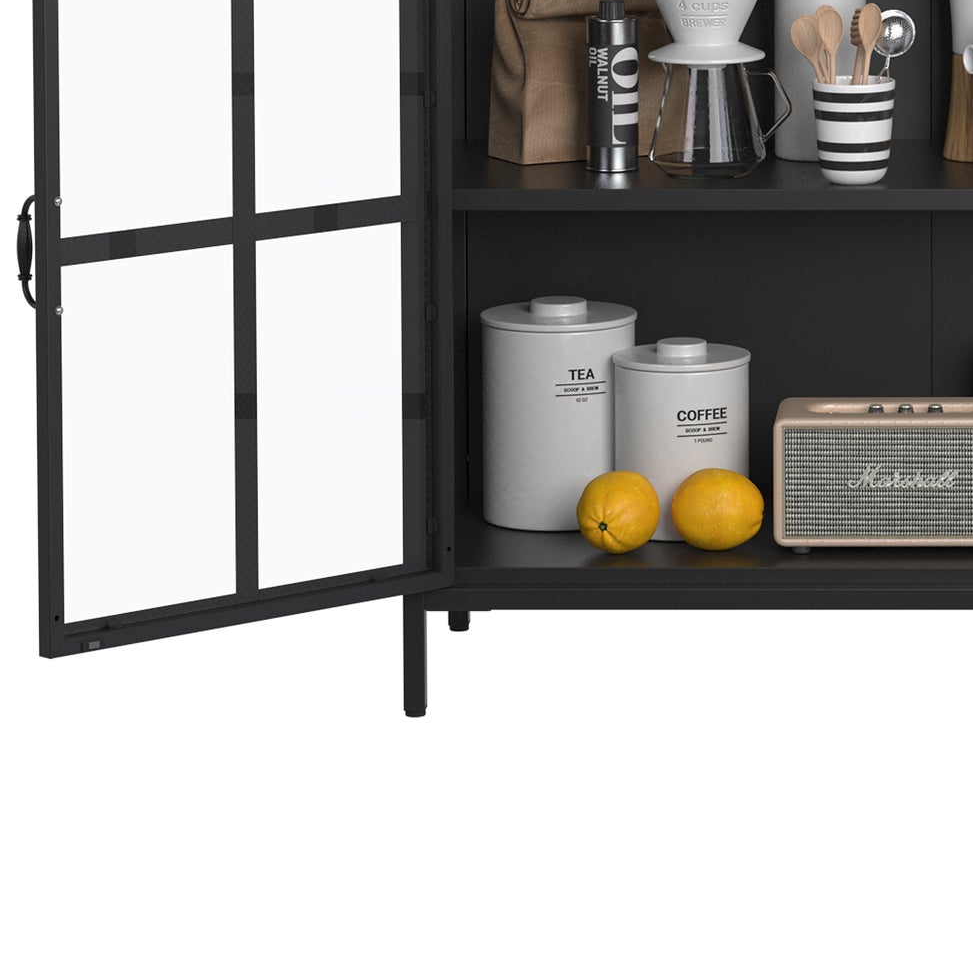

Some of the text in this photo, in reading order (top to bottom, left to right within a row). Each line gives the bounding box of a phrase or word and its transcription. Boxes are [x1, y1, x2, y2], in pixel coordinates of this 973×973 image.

[678, 0, 730, 13] 4 cups
[681, 18, 727, 27] BREWER
[588, 47, 598, 67] OIL
[597, 47, 609, 102] WALNUT
[611, 47, 638, 144] OIL
[568, 368, 595, 381] TEA
[676, 407, 728, 422] COFFEE
[847, 463, 959, 487] Marshall
